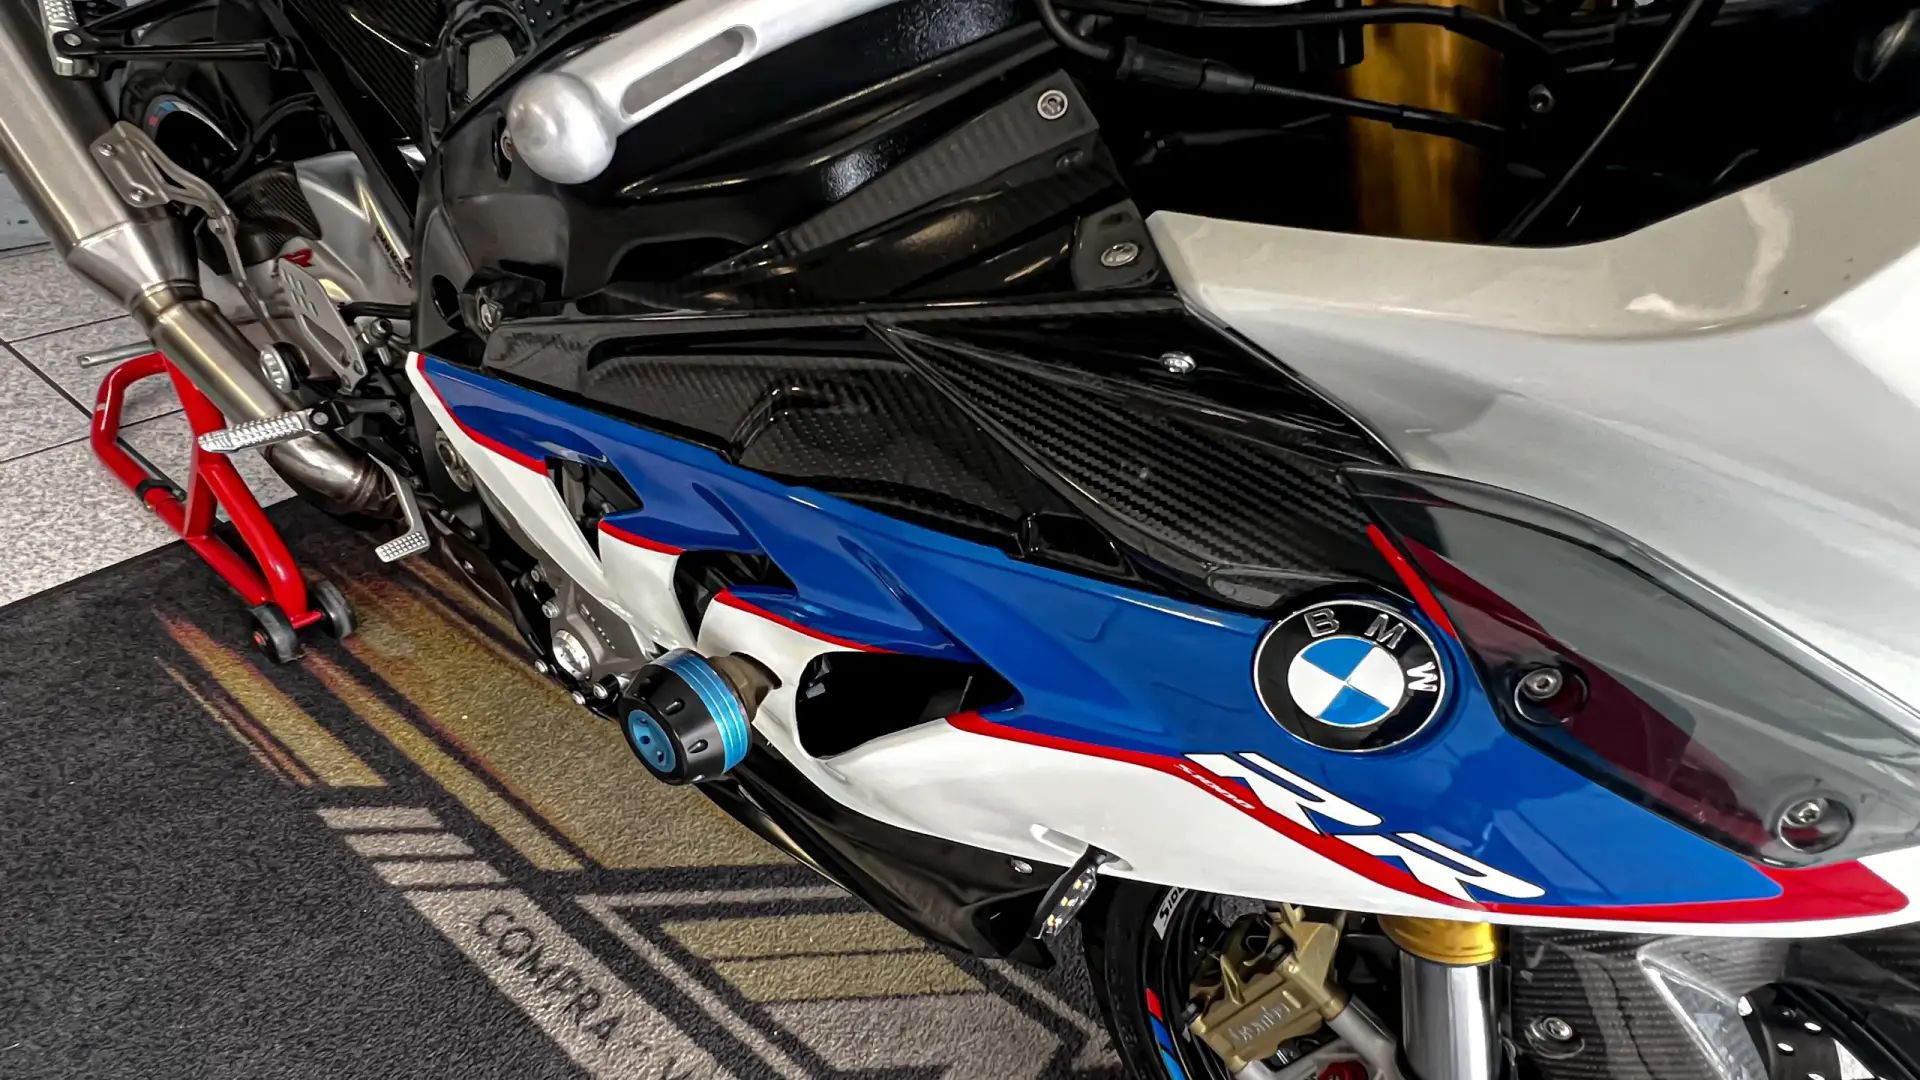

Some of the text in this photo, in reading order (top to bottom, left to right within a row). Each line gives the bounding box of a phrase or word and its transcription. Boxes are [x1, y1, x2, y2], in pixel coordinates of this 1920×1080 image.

[1304, 607, 1438, 692] BMW
[1183, 752, 1546, 903] RR
[1159, 887, 1184, 927] S10
[478, 908, 624, 1047] COMPRA
